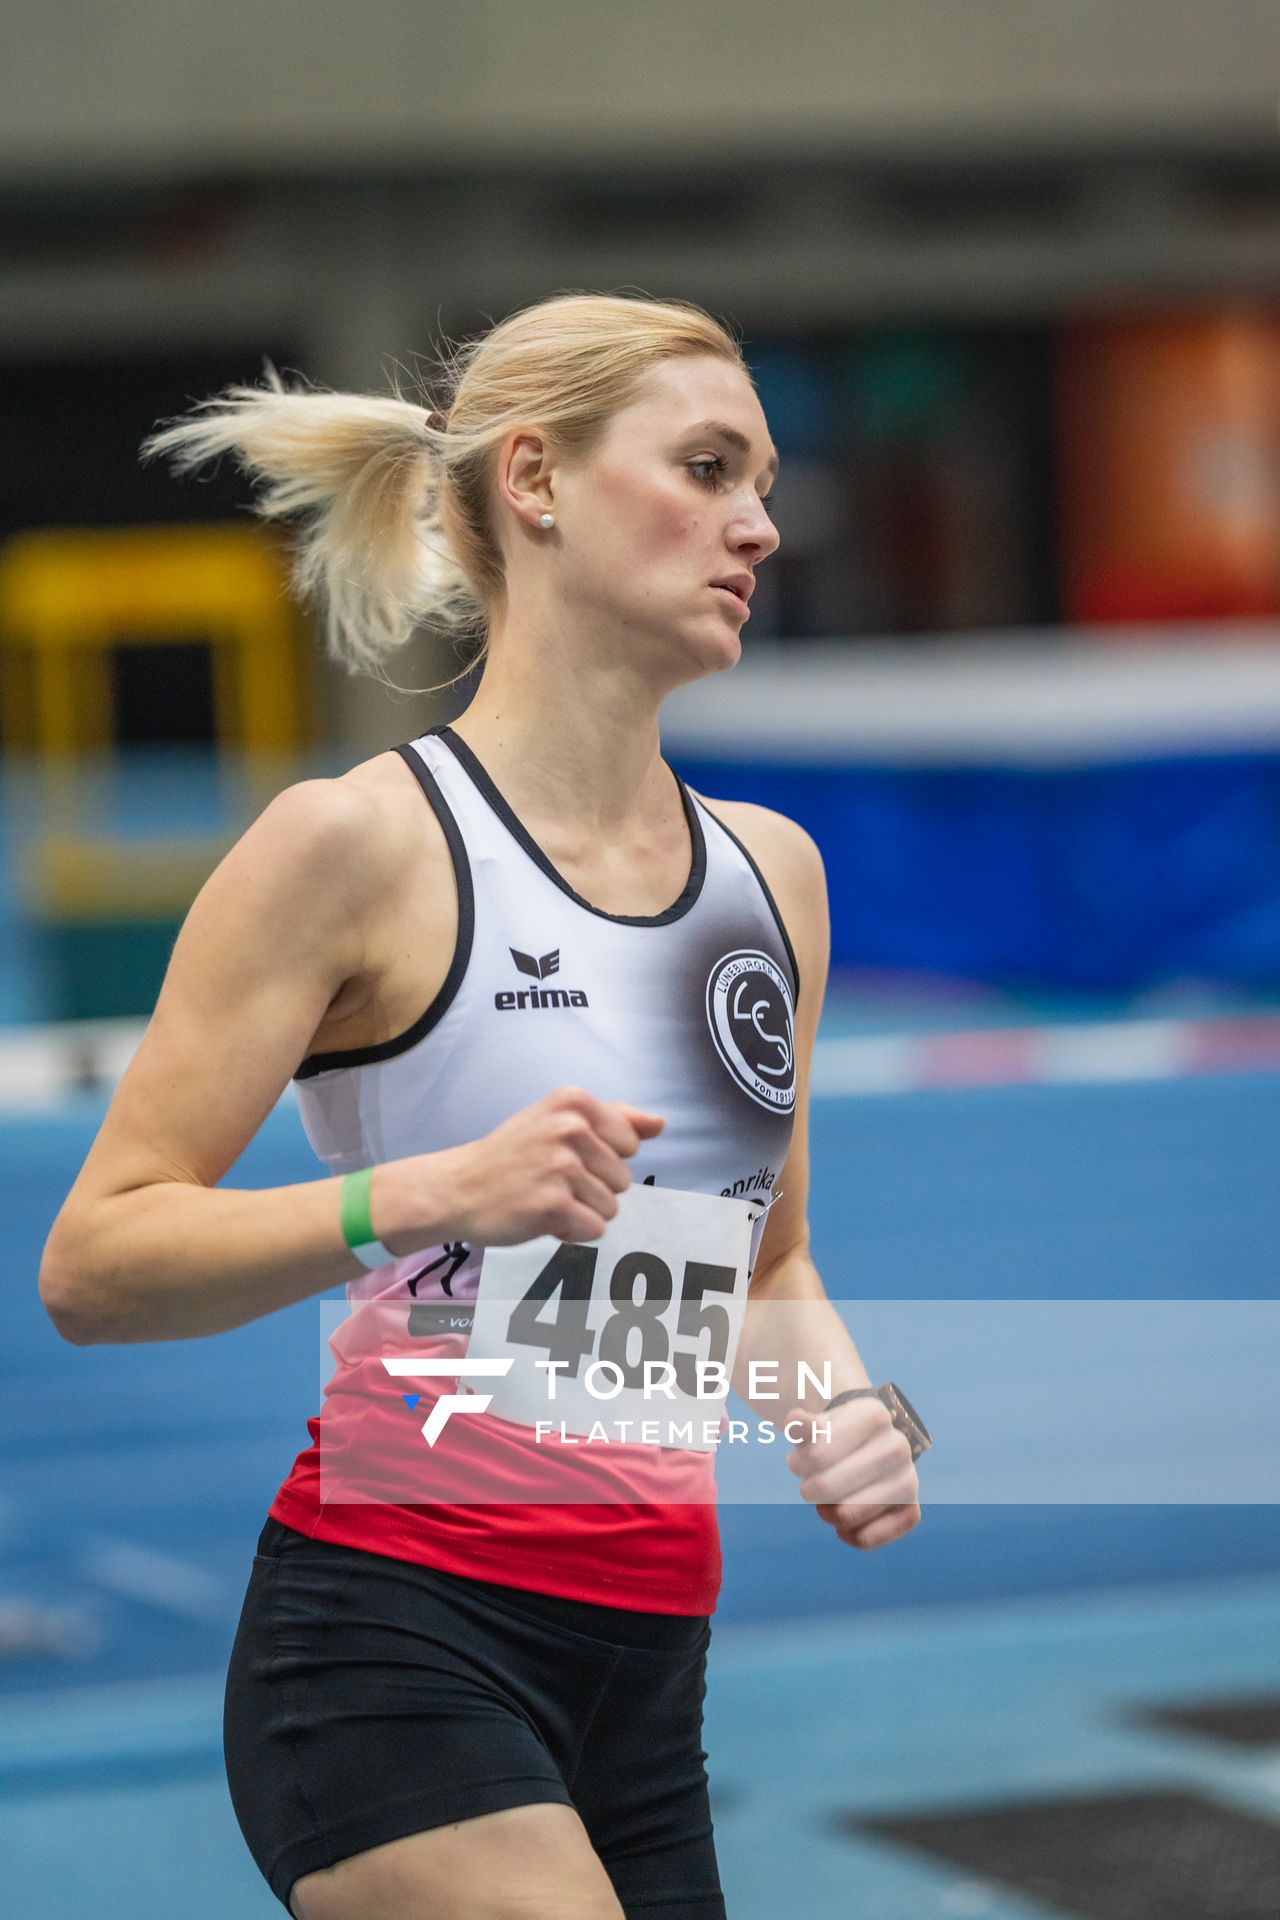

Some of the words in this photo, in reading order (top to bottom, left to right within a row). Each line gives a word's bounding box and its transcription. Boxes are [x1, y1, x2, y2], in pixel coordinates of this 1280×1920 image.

[495, 985, 589, 1011] erima
[754, 1078, 771, 1098] von
[506, 1242, 737, 1398] 485
